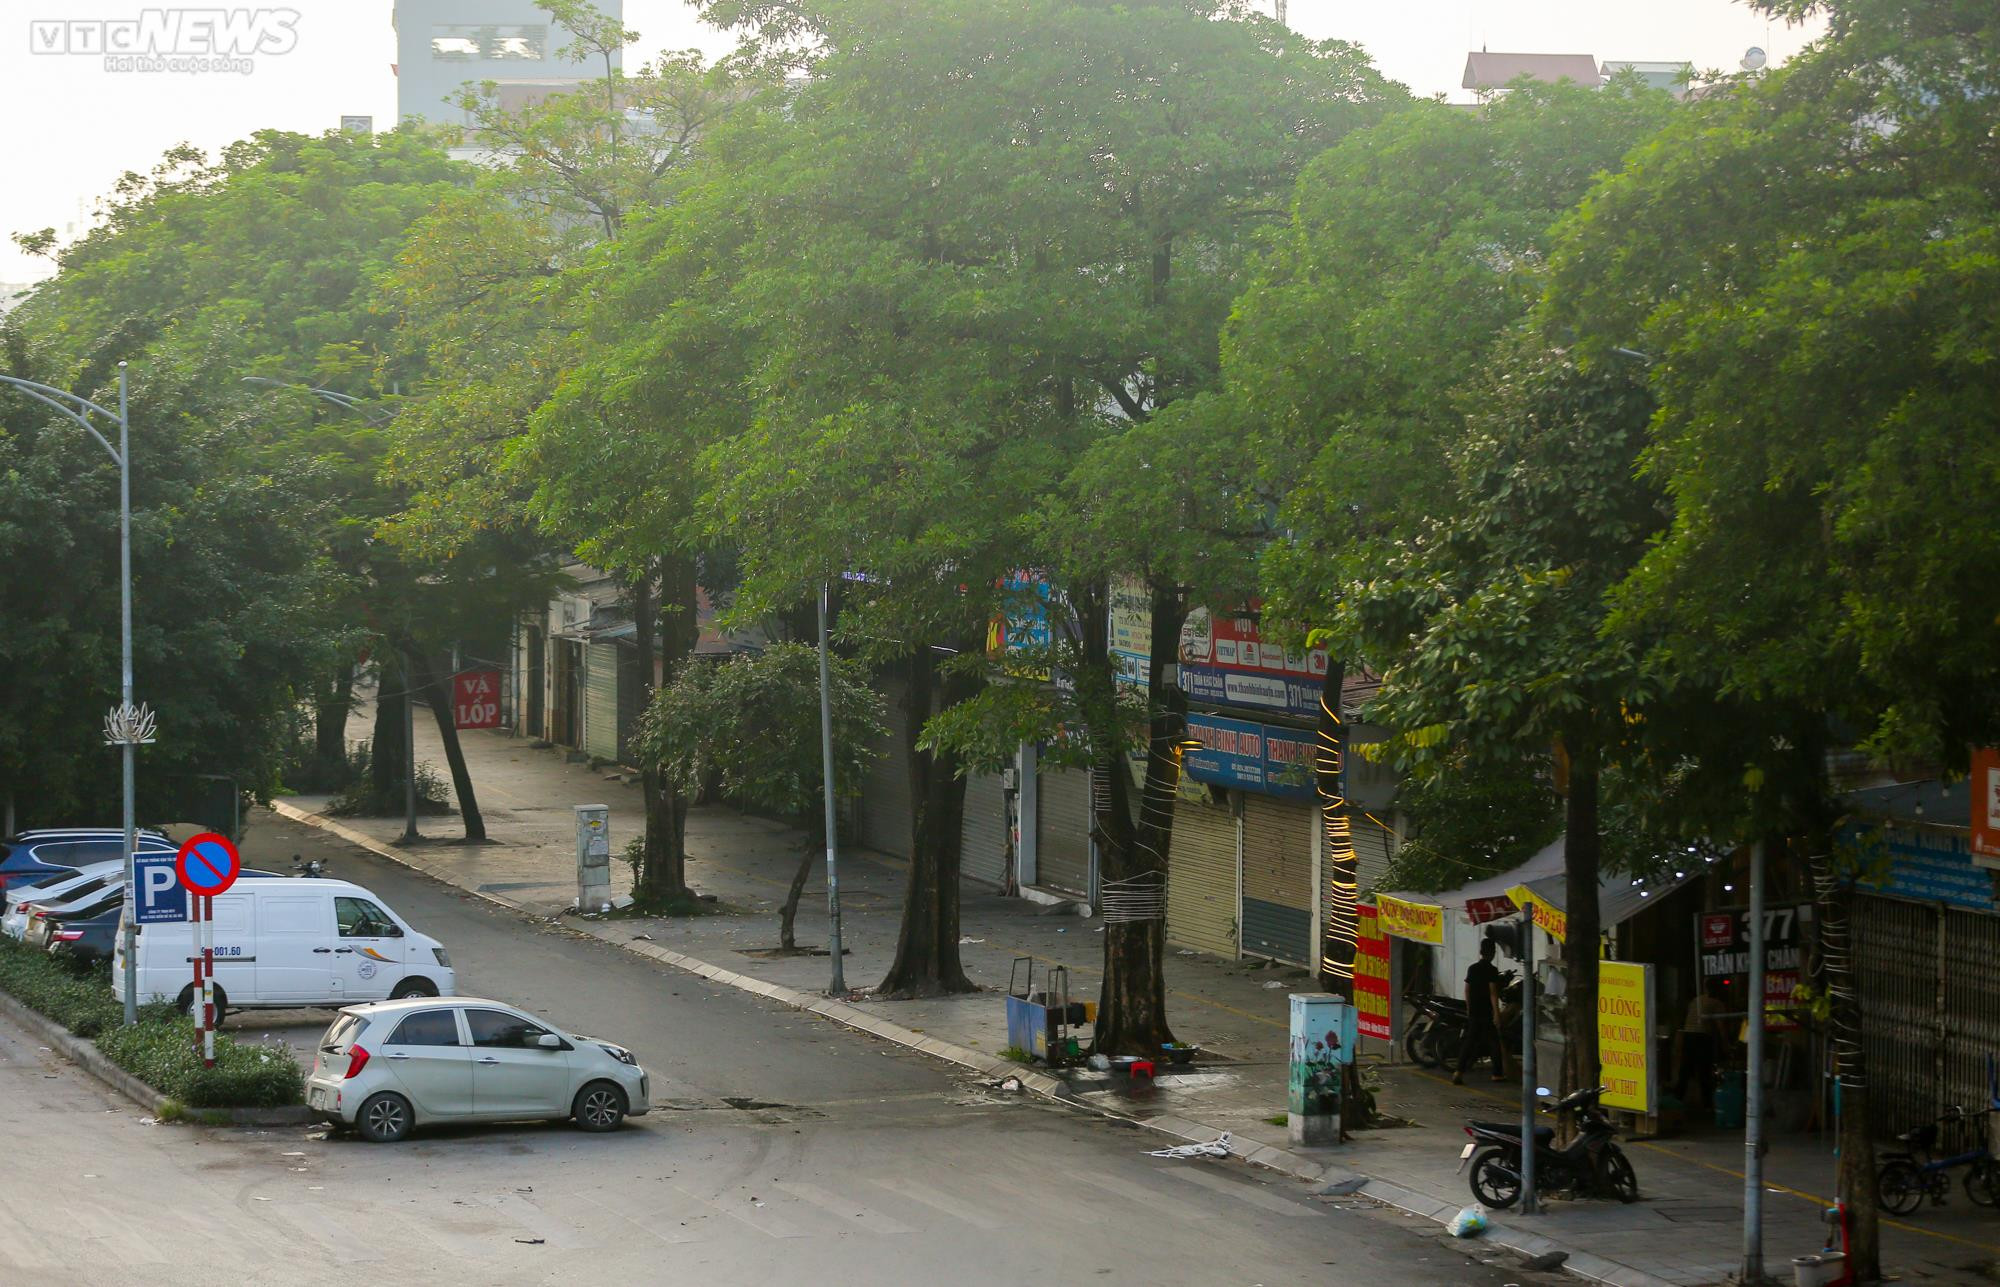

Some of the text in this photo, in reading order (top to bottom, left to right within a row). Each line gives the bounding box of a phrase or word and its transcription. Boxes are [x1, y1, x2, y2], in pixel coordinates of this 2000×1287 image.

[459, 695, 497, 724] LỐP
[1238, 732, 1261, 759] AUTO
[1267, 737, 1297, 764] THANH
[144, 865, 176, 907] P
